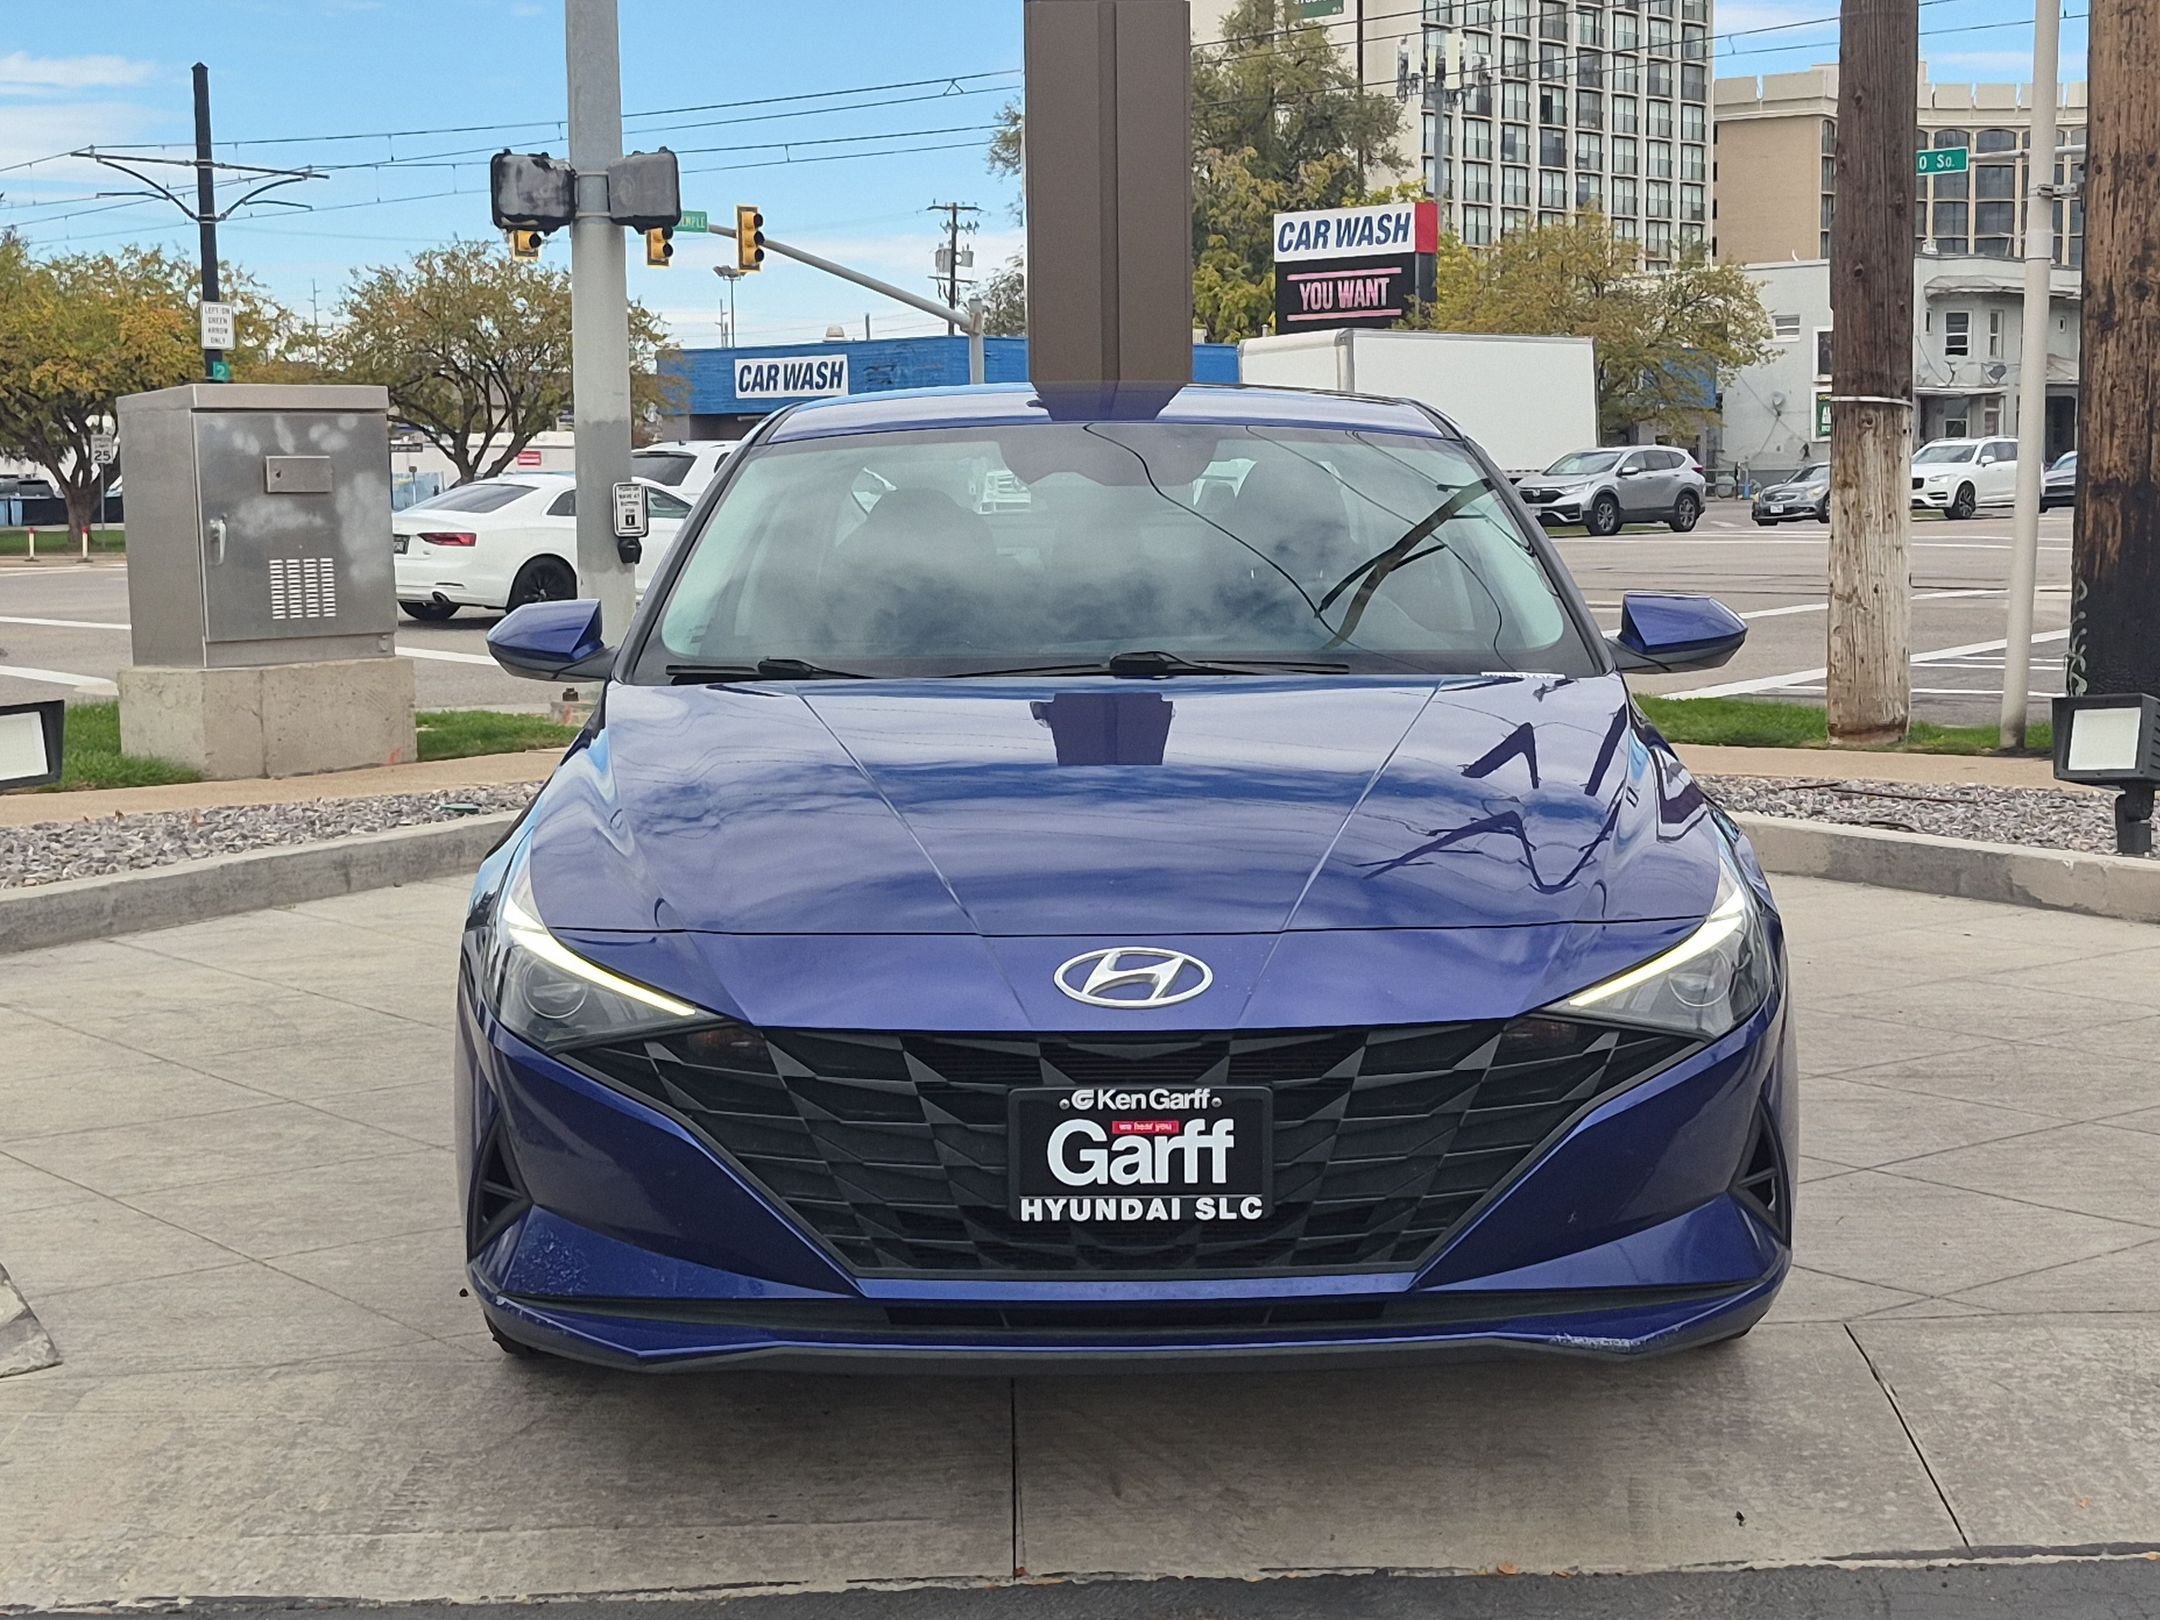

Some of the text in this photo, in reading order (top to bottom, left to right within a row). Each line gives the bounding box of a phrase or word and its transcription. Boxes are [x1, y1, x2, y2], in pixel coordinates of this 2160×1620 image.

[1936, 154, 1955, 169] So.
[680, 216, 705, 228] EMPLE
[1277, 212, 1412, 253] CAR WASH
[1299, 277, 1390, 311] YOU WANT
[204, 306, 230, 315] LEFT ON
[207, 316, 228, 324] GREEN
[210, 337, 226, 345] ONLY
[738, 361, 844, 393] CAR WASH
[94, 450, 111, 461] 25
[1097, 1088, 1211, 1111] Ken Garff
[1118, 1121, 1173, 1133] we hear you
[1047, 1118, 1235, 1187] Garff
[1020, 1196, 1263, 1222] HYUNDAI SLC
